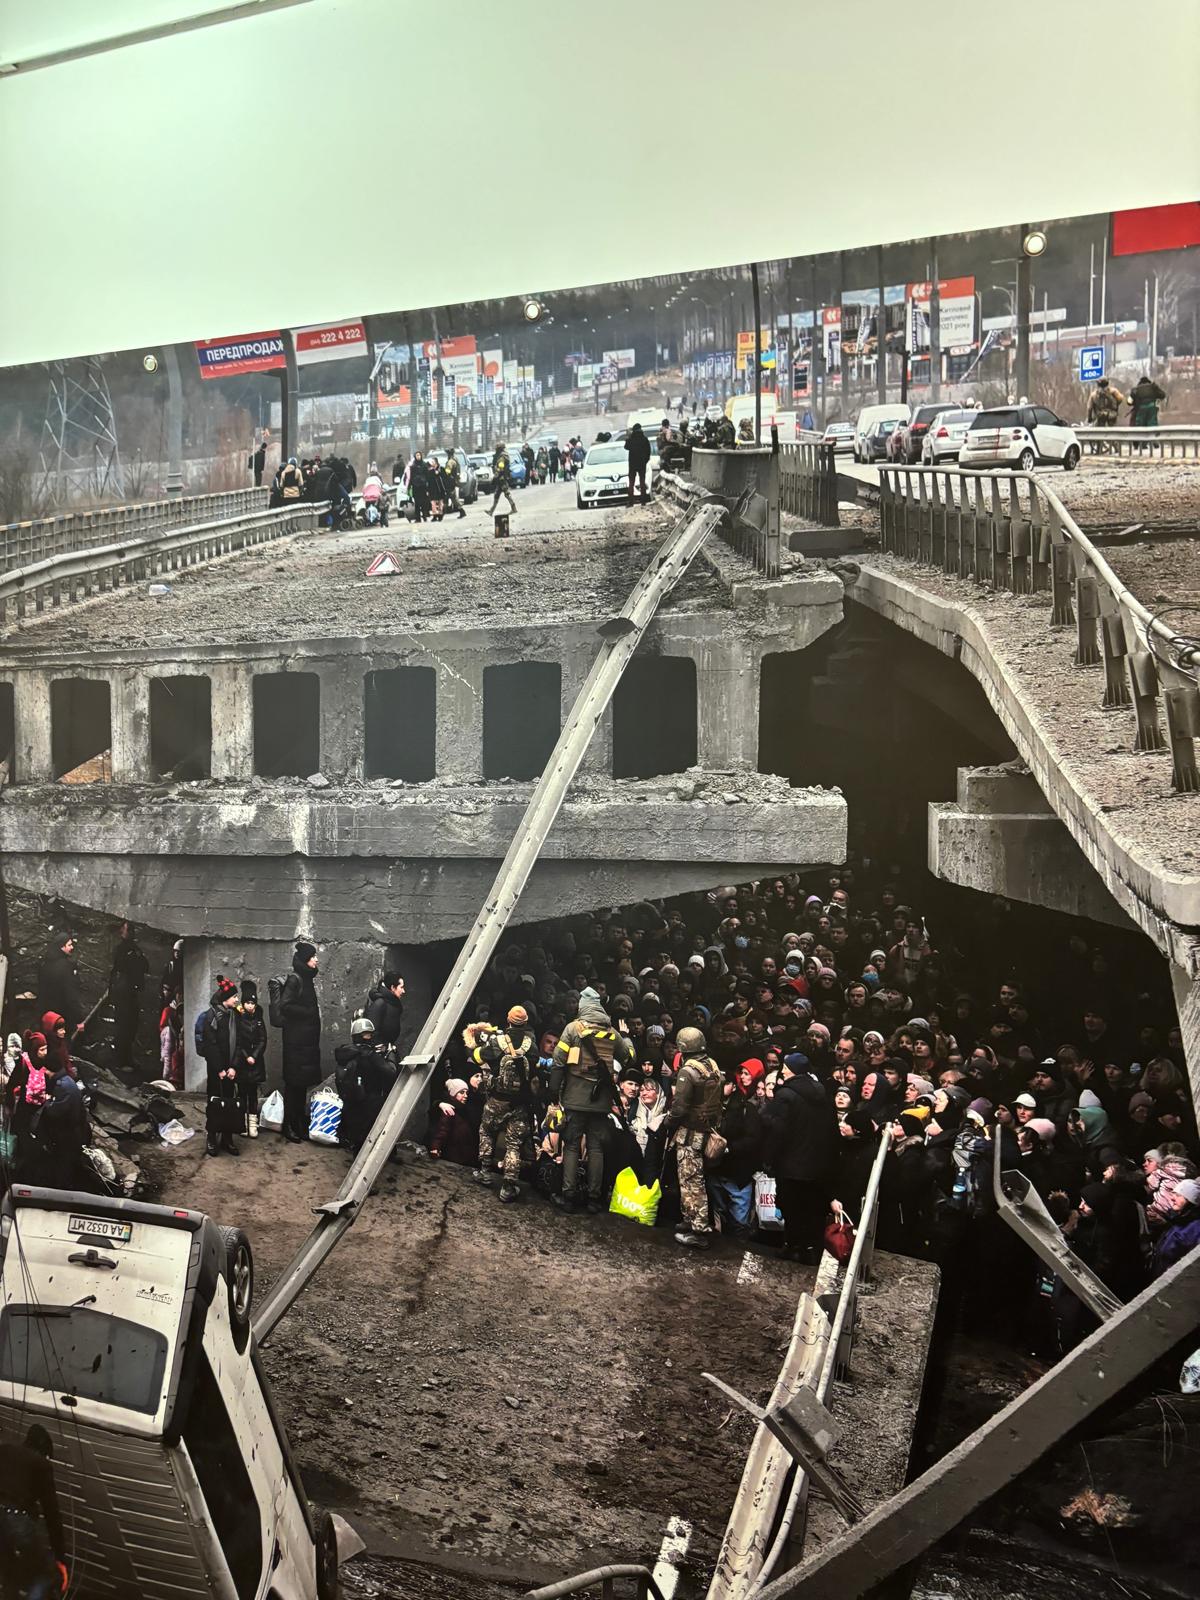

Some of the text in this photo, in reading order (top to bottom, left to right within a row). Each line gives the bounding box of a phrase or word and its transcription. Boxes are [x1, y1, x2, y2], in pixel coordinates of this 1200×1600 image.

[320, 332, 337, 343] 222
[338, 331, 344, 341] 4
[345, 328, 361, 339] 222
[71, 1218, 125, 1236] AA 0332 MT
